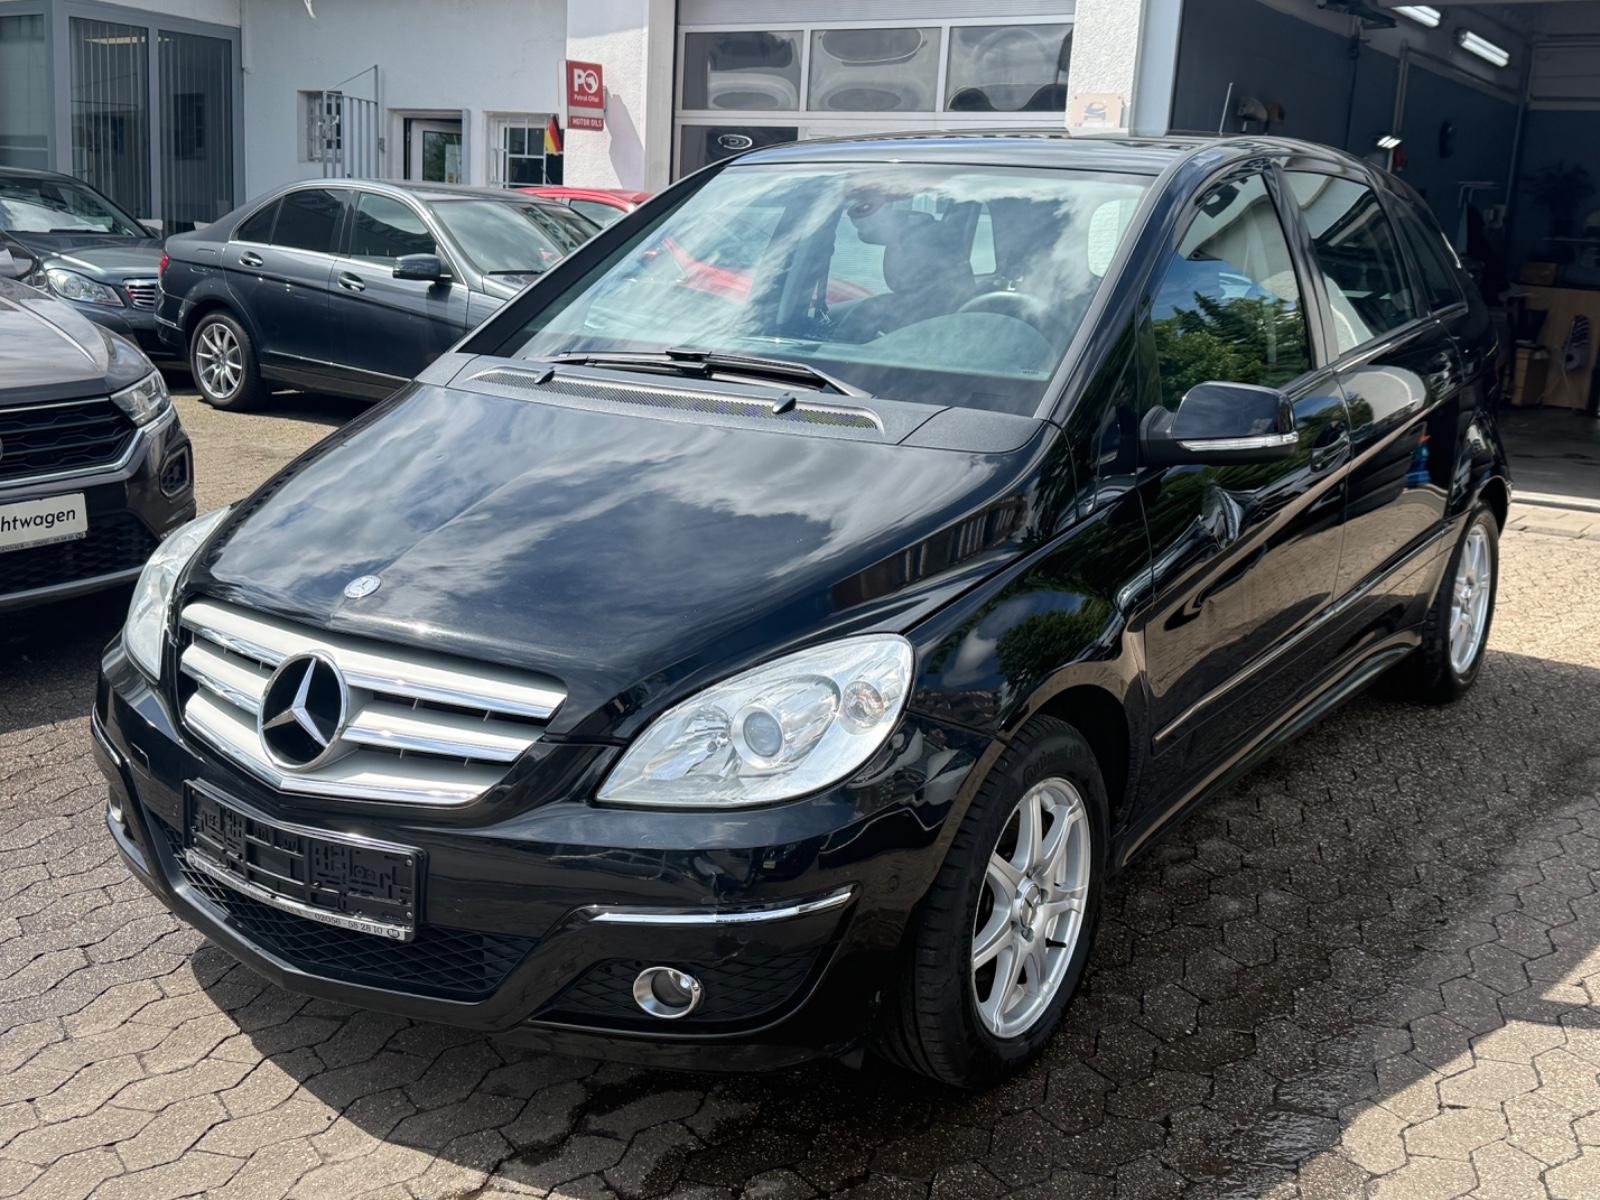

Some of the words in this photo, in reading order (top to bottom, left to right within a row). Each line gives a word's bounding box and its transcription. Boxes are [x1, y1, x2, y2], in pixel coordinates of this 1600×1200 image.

[572, 118, 590, 126] MOTOR
[591, 119, 602, 127] OILS
[360, 923, 371, 932] 28
[373, 926, 383, 935] 10
